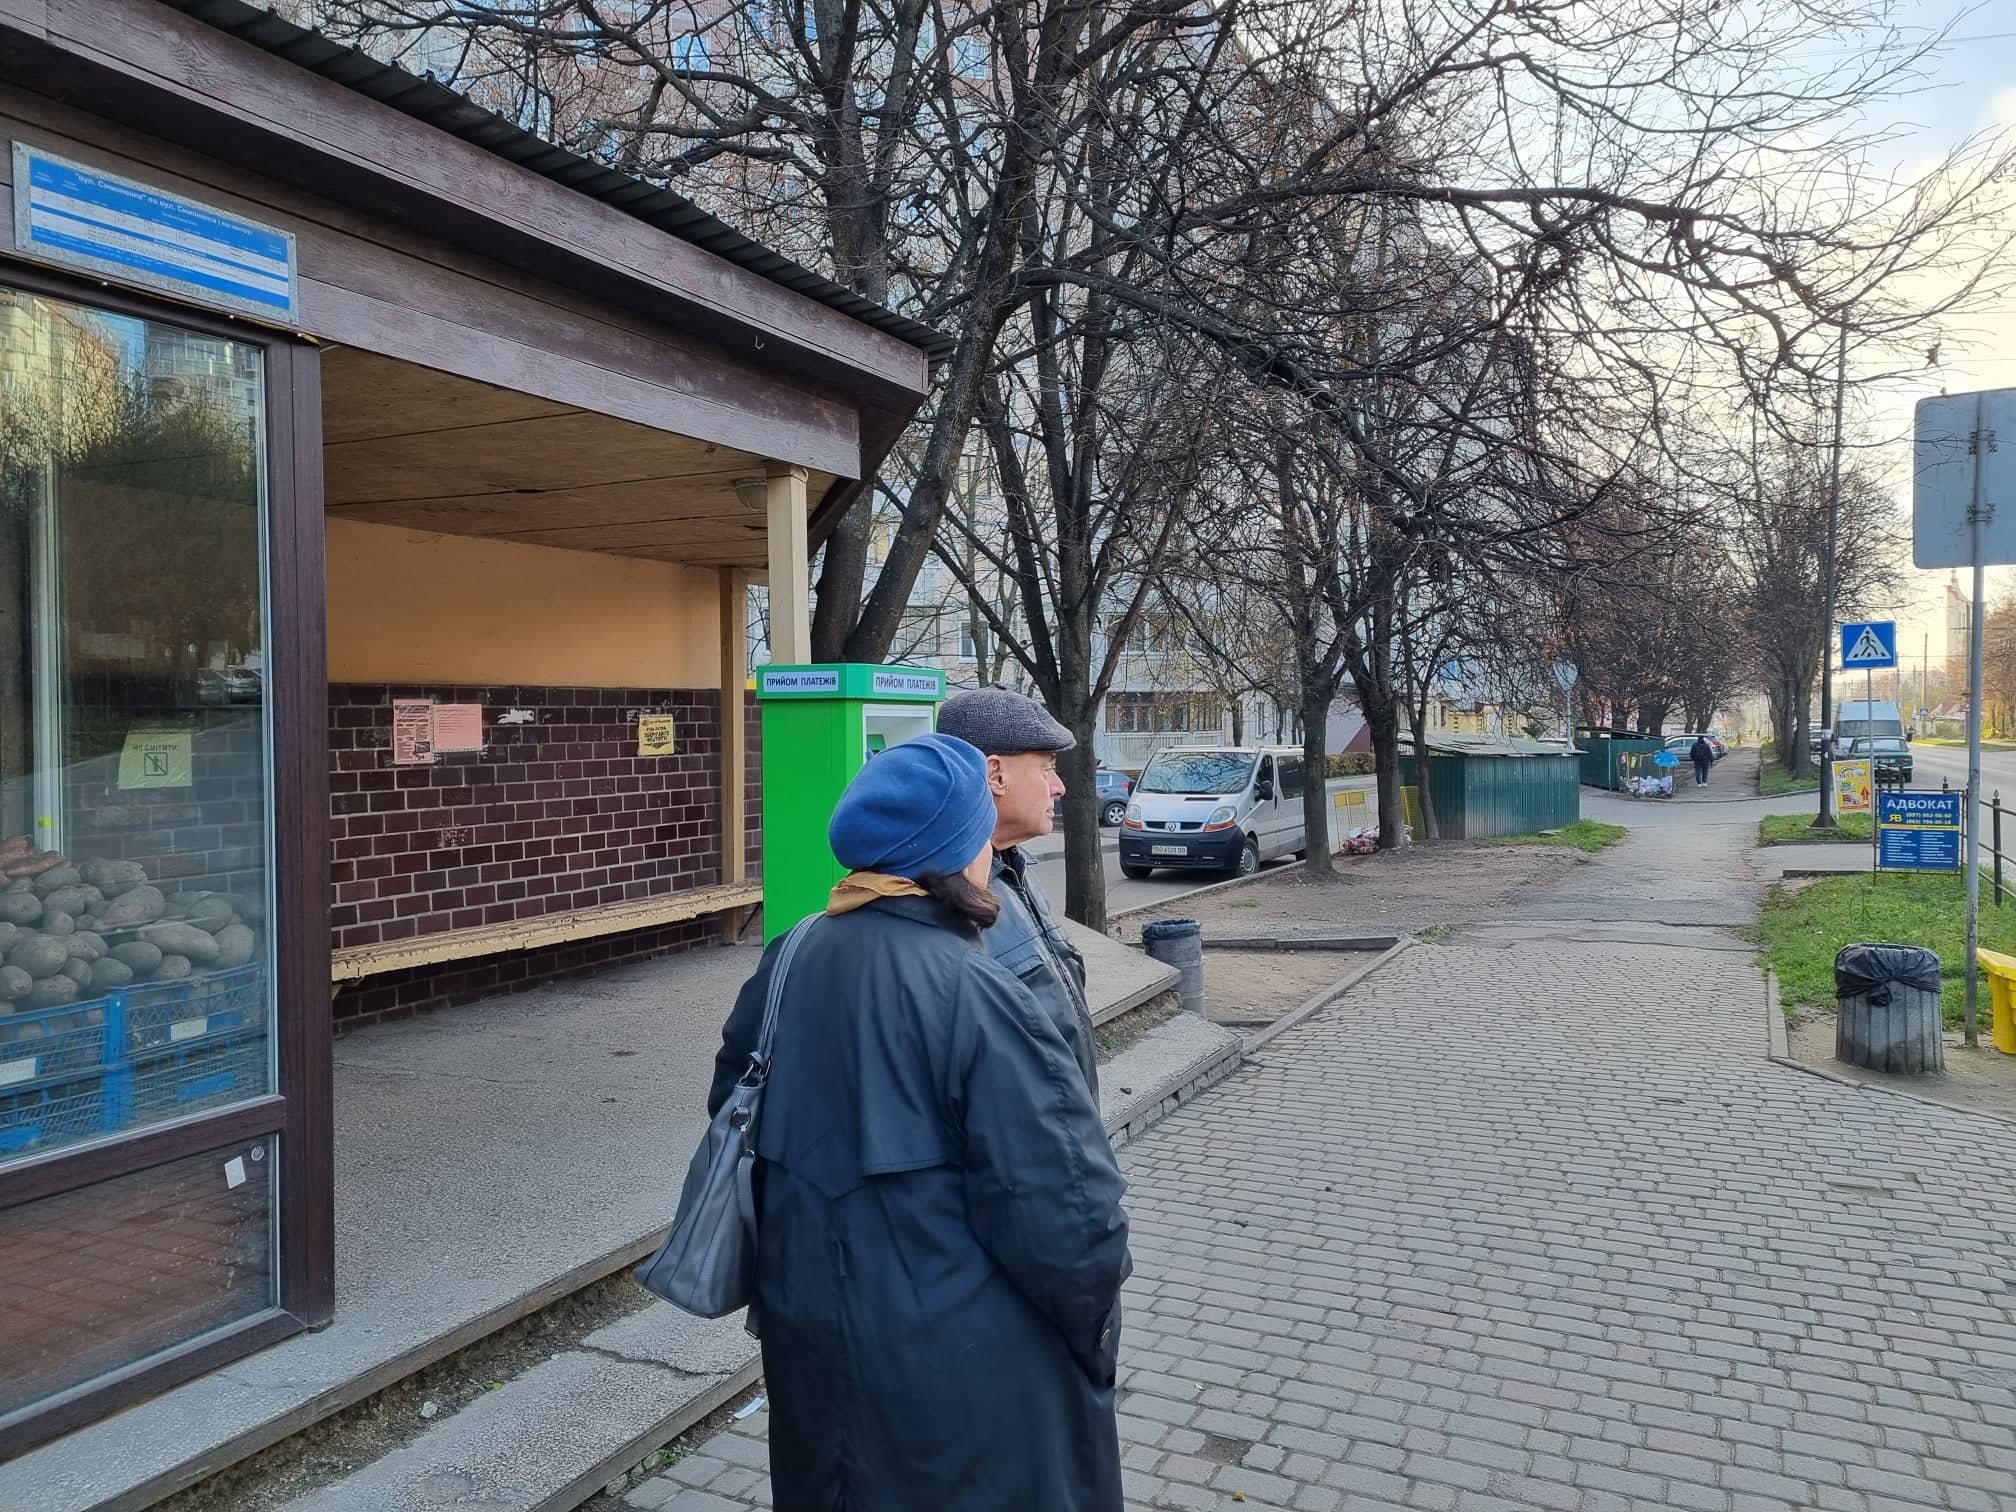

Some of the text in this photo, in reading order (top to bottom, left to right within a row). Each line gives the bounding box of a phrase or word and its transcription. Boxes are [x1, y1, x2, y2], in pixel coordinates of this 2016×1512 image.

[766, 676, 837, 687] ПРИЙОМ ПЛАТЕЖІВ
[875, 675, 937, 691] ПРИЙОМ ПЛАТЕЖІВ
[1887, 799, 1954, 811] АДВОКАТ
